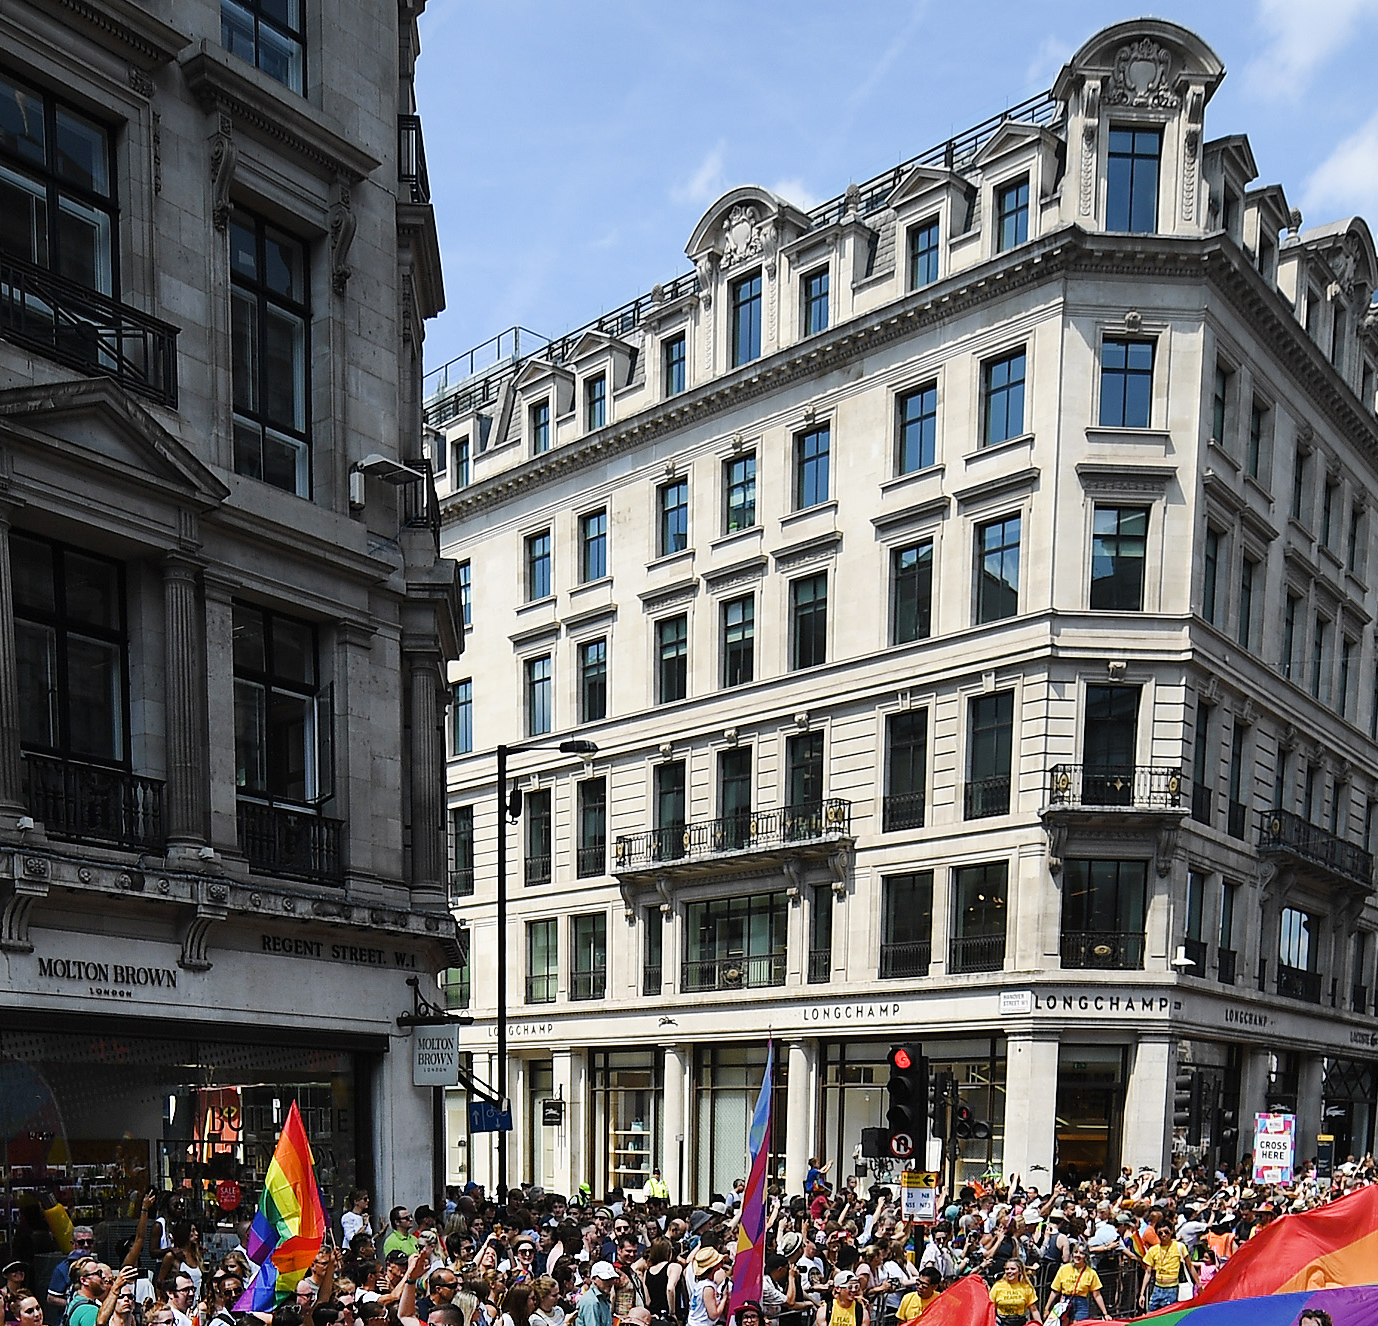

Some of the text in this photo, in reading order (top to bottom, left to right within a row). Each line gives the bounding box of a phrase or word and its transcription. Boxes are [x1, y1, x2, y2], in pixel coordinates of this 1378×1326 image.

[262, 935, 323, 957] REGENT
[394, 951, 416, 968] W.1
[38, 957, 177, 988] MOLTON BROWN
[89, 987, 133, 998] LONDON
[1034, 995, 1170, 1012] LONGCHAMP
[803, 1004, 901, 1021] LONGCHAMP
[1225, 1008, 1268, 1027] LONGCHAMP
[488, 1024, 554, 1038] LOGCHAMP
[418, 1038, 454, 1050] MOLTON
[418, 1053, 454, 1066] BROWN
[1260, 1141, 1288, 1150] CROSS
[1262, 1151, 1284, 1160] HERE
[220, 1187, 236, 1195] SALE
